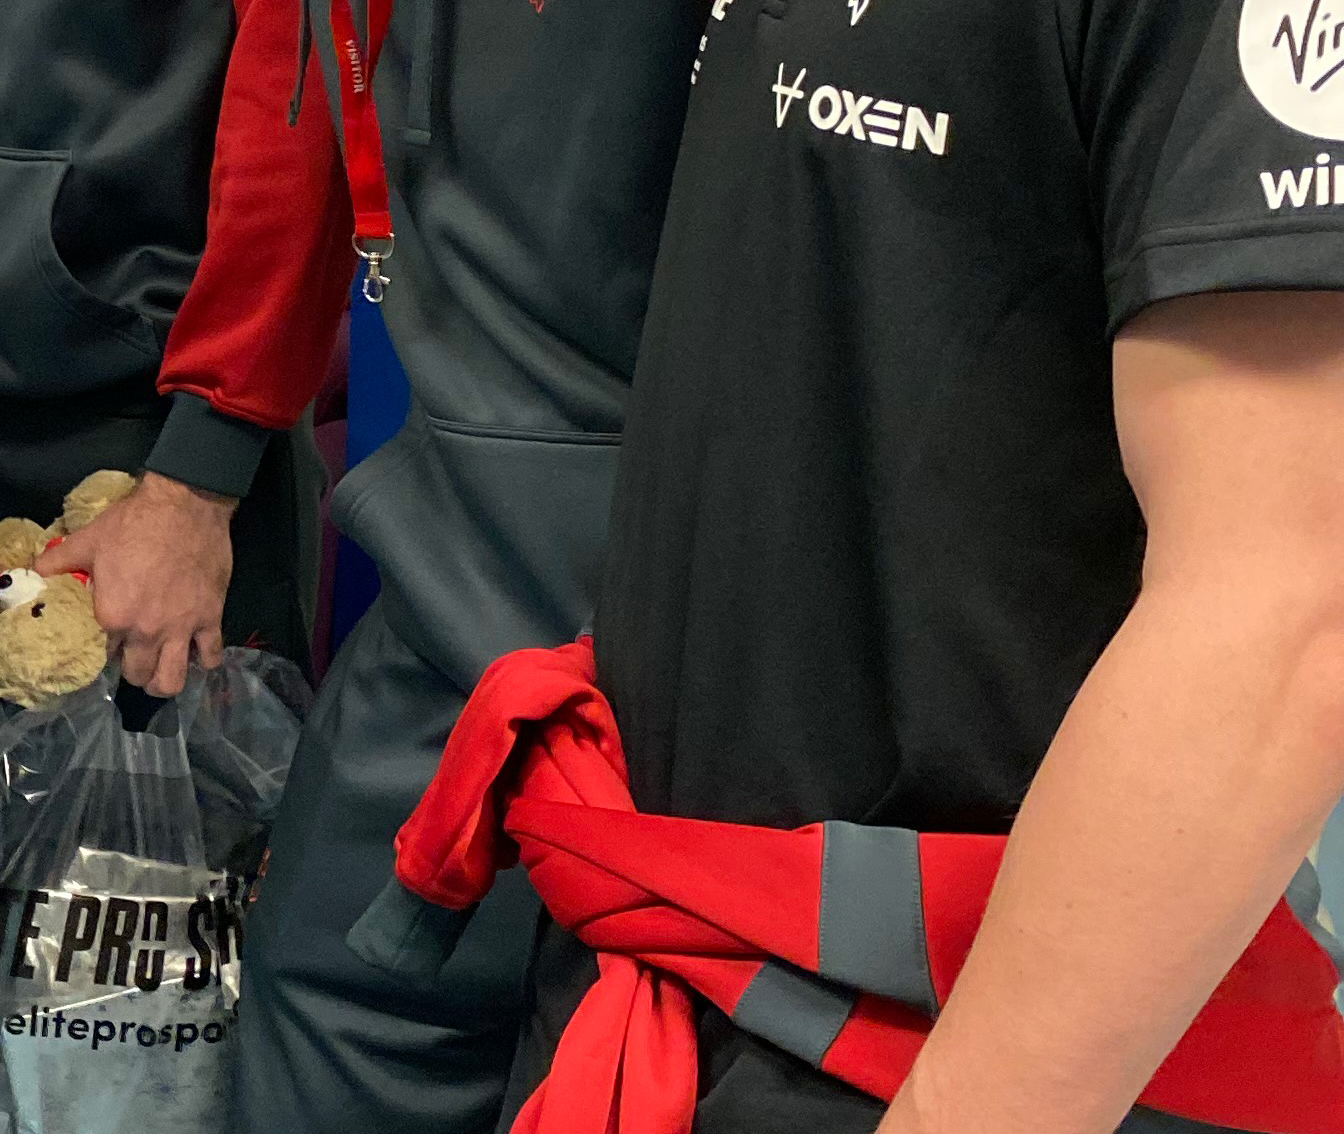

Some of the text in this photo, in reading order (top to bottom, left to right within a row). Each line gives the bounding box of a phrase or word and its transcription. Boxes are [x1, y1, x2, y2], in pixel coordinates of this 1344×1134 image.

[346, 39, 365, 93] VISITOR
[808, 84, 950, 156] OXEN
[55, 893, 169, 991] PRO
